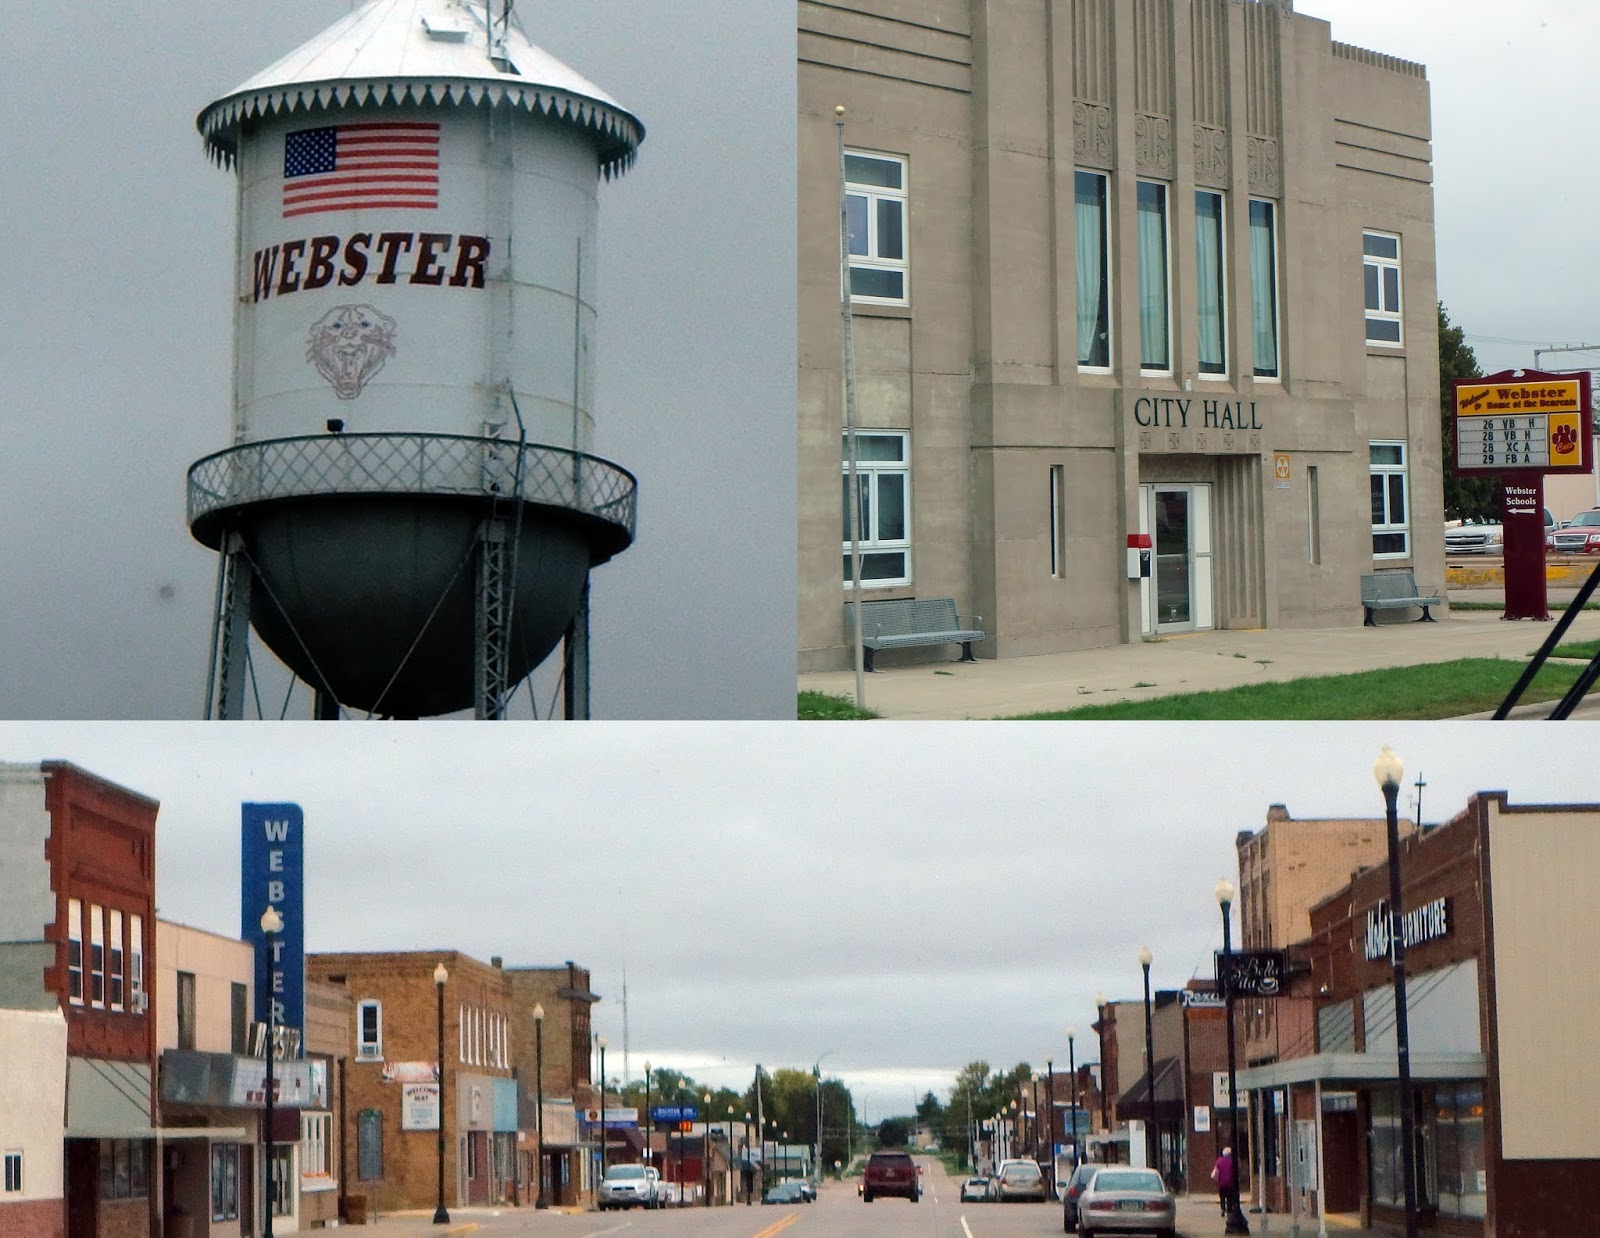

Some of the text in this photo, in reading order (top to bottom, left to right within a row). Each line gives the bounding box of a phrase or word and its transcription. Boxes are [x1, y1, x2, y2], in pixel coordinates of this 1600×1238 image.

[252, 231, 491, 304] WEBSTER
[1496, 387, 1567, 400] Webster
[1486, 398, 1577, 410] Home of the Bearcats
[1134, 397, 1263, 430] CITY HALL
[1483, 418, 1535, 430] 26 VB H
[1482, 430, 1531, 441] 28 VB H
[1482, 442, 1531, 453] 28 XC A
[1556, 442, 1573, 452] Cats
[1482, 453, 1531, 464] 29 FB A
[1505, 486, 1537, 495] Webster
[1506, 497, 1537, 506] Schools
[1399, 896, 1447, 949] URNITURE
